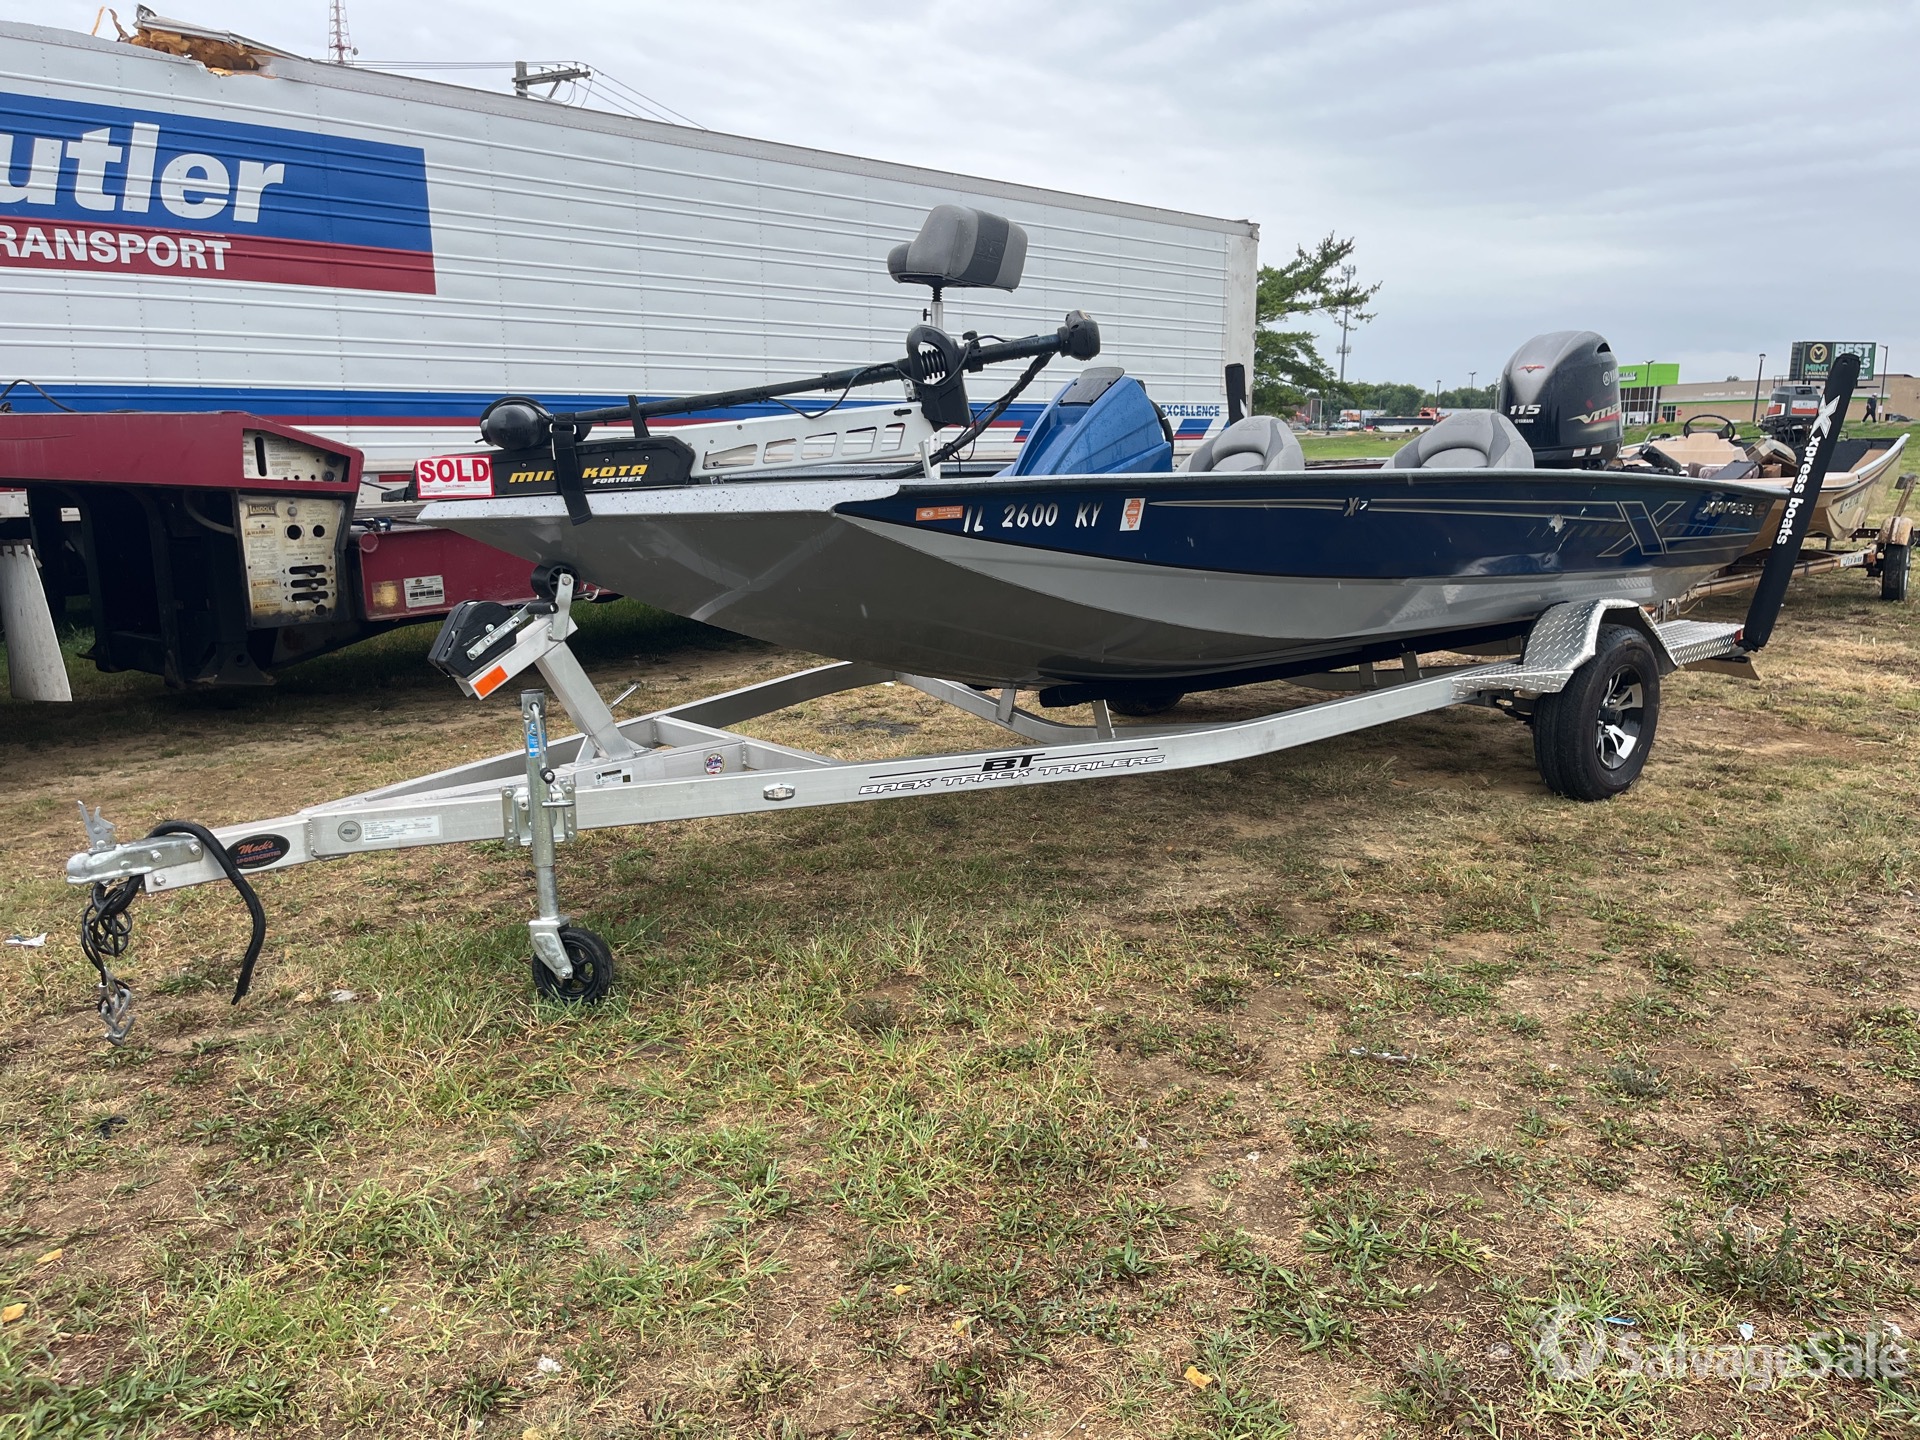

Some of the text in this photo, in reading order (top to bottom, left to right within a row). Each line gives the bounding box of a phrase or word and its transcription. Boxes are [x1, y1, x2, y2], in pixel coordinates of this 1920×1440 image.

[1835, 343, 1873, 357] BEST
[1805, 363, 1829, 372] MINT
[1160, 404, 1220, 417] EXCELLENCE
[1509, 404, 1542, 415] 115
[420, 459, 489, 483] SOLD
[582, 464, 648, 479] KOTA
[1793, 435, 1822, 495] xpress
[592, 475, 643, 485] FORTREX
[249, 504, 275, 515] LANDOLL
[964, 505, 984, 533] IL
[1001, 503, 1059, 528] 2600
[1074, 501, 1104, 529] KY
[1776, 497, 1805, 546] boats
[982, 752, 1046, 773] BT
[858, 755, 1166, 795] BACK TRACK TRAILERS
